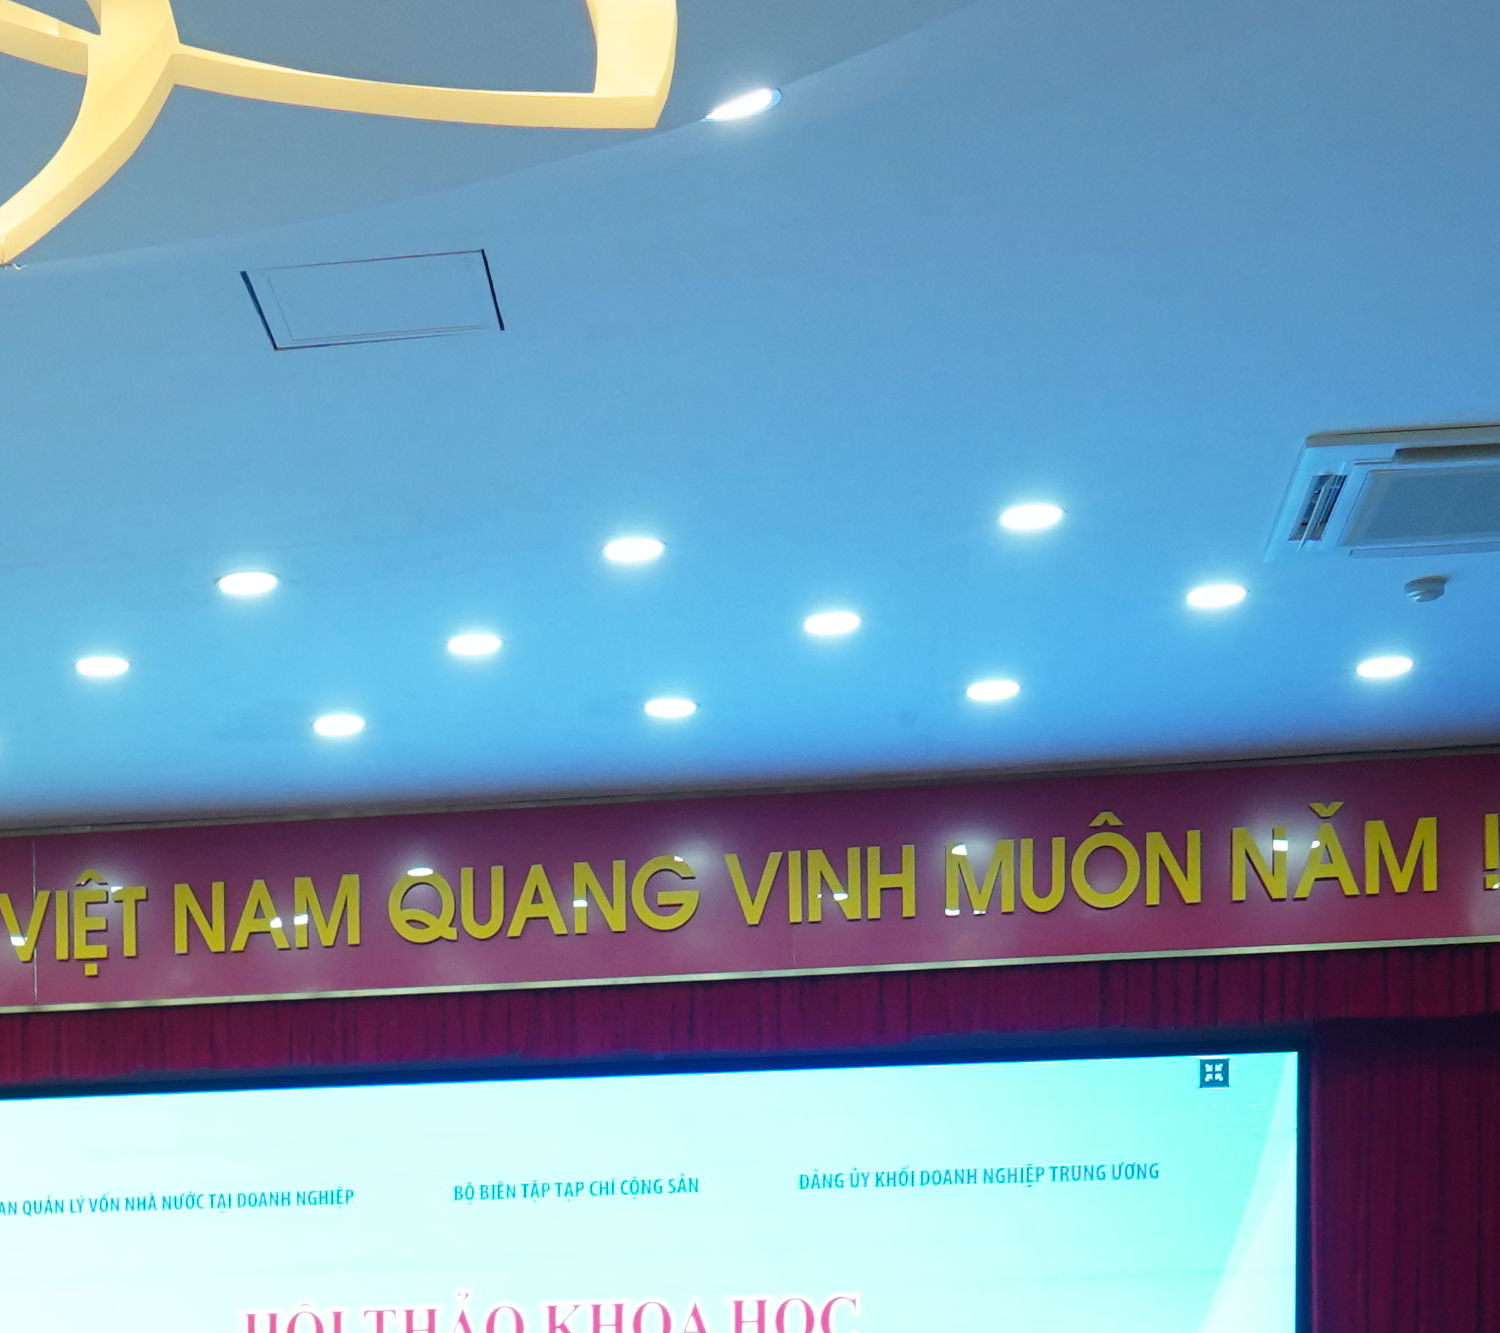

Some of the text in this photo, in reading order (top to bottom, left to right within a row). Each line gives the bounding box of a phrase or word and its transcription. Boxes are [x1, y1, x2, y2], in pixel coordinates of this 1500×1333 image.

[174, 873, 361, 955] NAM
[388, 855, 700, 945] QUANG
[724, 843, 916, 927] VINH
[944, 811, 1202, 915] MUÔN
[1230, 801, 1439, 902] NĂM
[453, 1172, 699, 1202] BỘ BIÊN TẬP TẠP CHÍ CỘNG SẢN
[798, 1168, 845, 1191] ĐẢNG
[873, 1165, 916, 1188] KHỐI
[919, 1168, 978, 1187] DOANH
[982, 1163, 1046, 1188] NGHIỆP
[1047, 1163, 1107, 1183] TRUNG
[1110, 1161, 1160, 1181] ƯƠNG
[21, 1194, 65, 1217] QUẢN
[69, 1197, 86, 1214] LÝ
[87, 1193, 120, 1214] VỐN
[124, 1192, 158, 1212] NHÀ
[161, 1191, 205, 1211] NƯỚC
[208, 1192, 233, 1210] TẠI
[236, 1190, 292, 1209] DOANH
[295, 1186, 355, 1207] NGHIỆP
